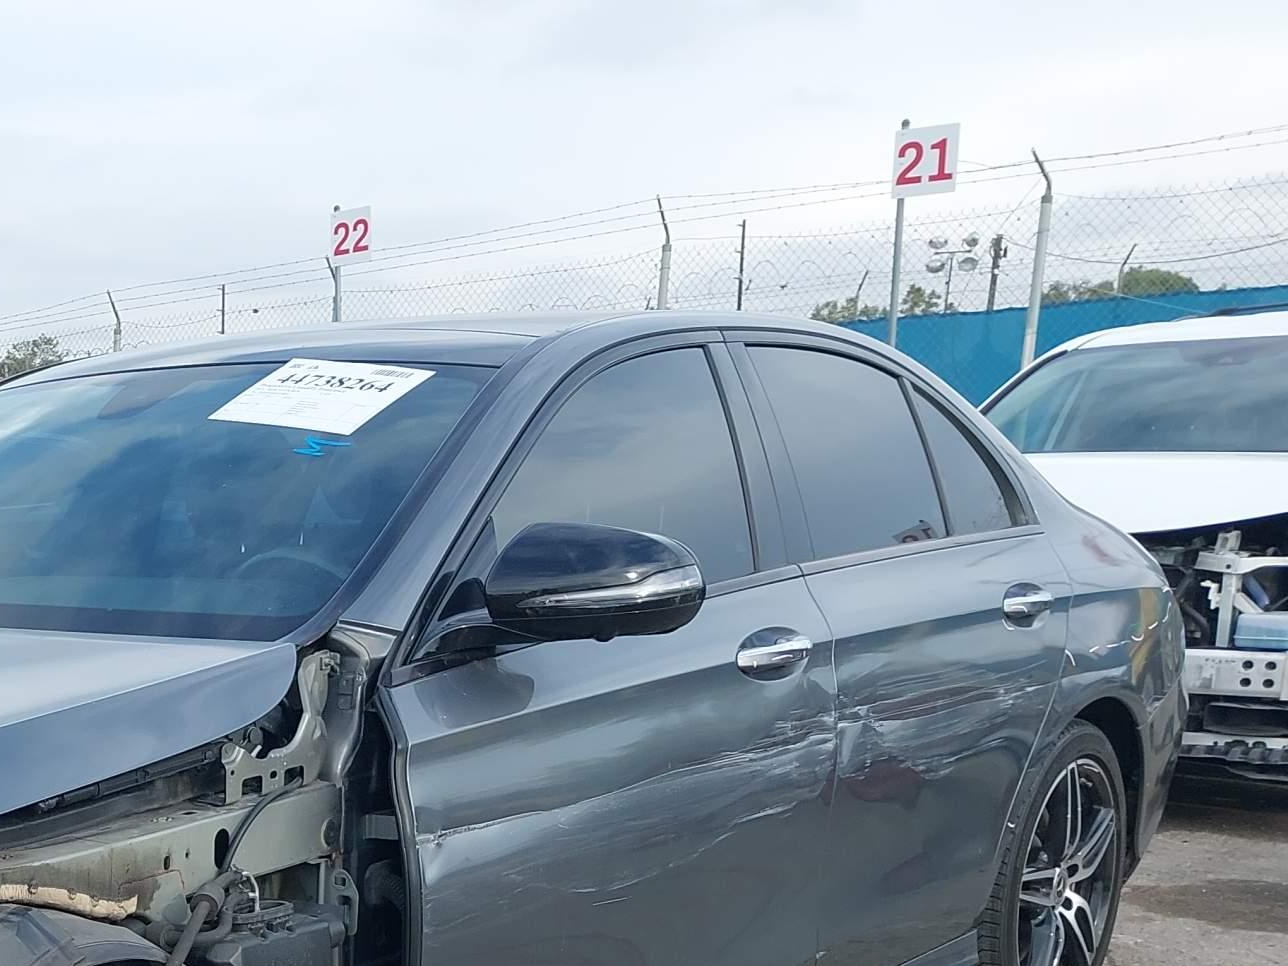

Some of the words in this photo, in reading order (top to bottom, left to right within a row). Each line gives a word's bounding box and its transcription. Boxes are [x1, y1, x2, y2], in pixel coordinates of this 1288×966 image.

[896, 138, 953, 186] 21
[333, 218, 369, 256] 22
[277, 373, 396, 393] 44738264
